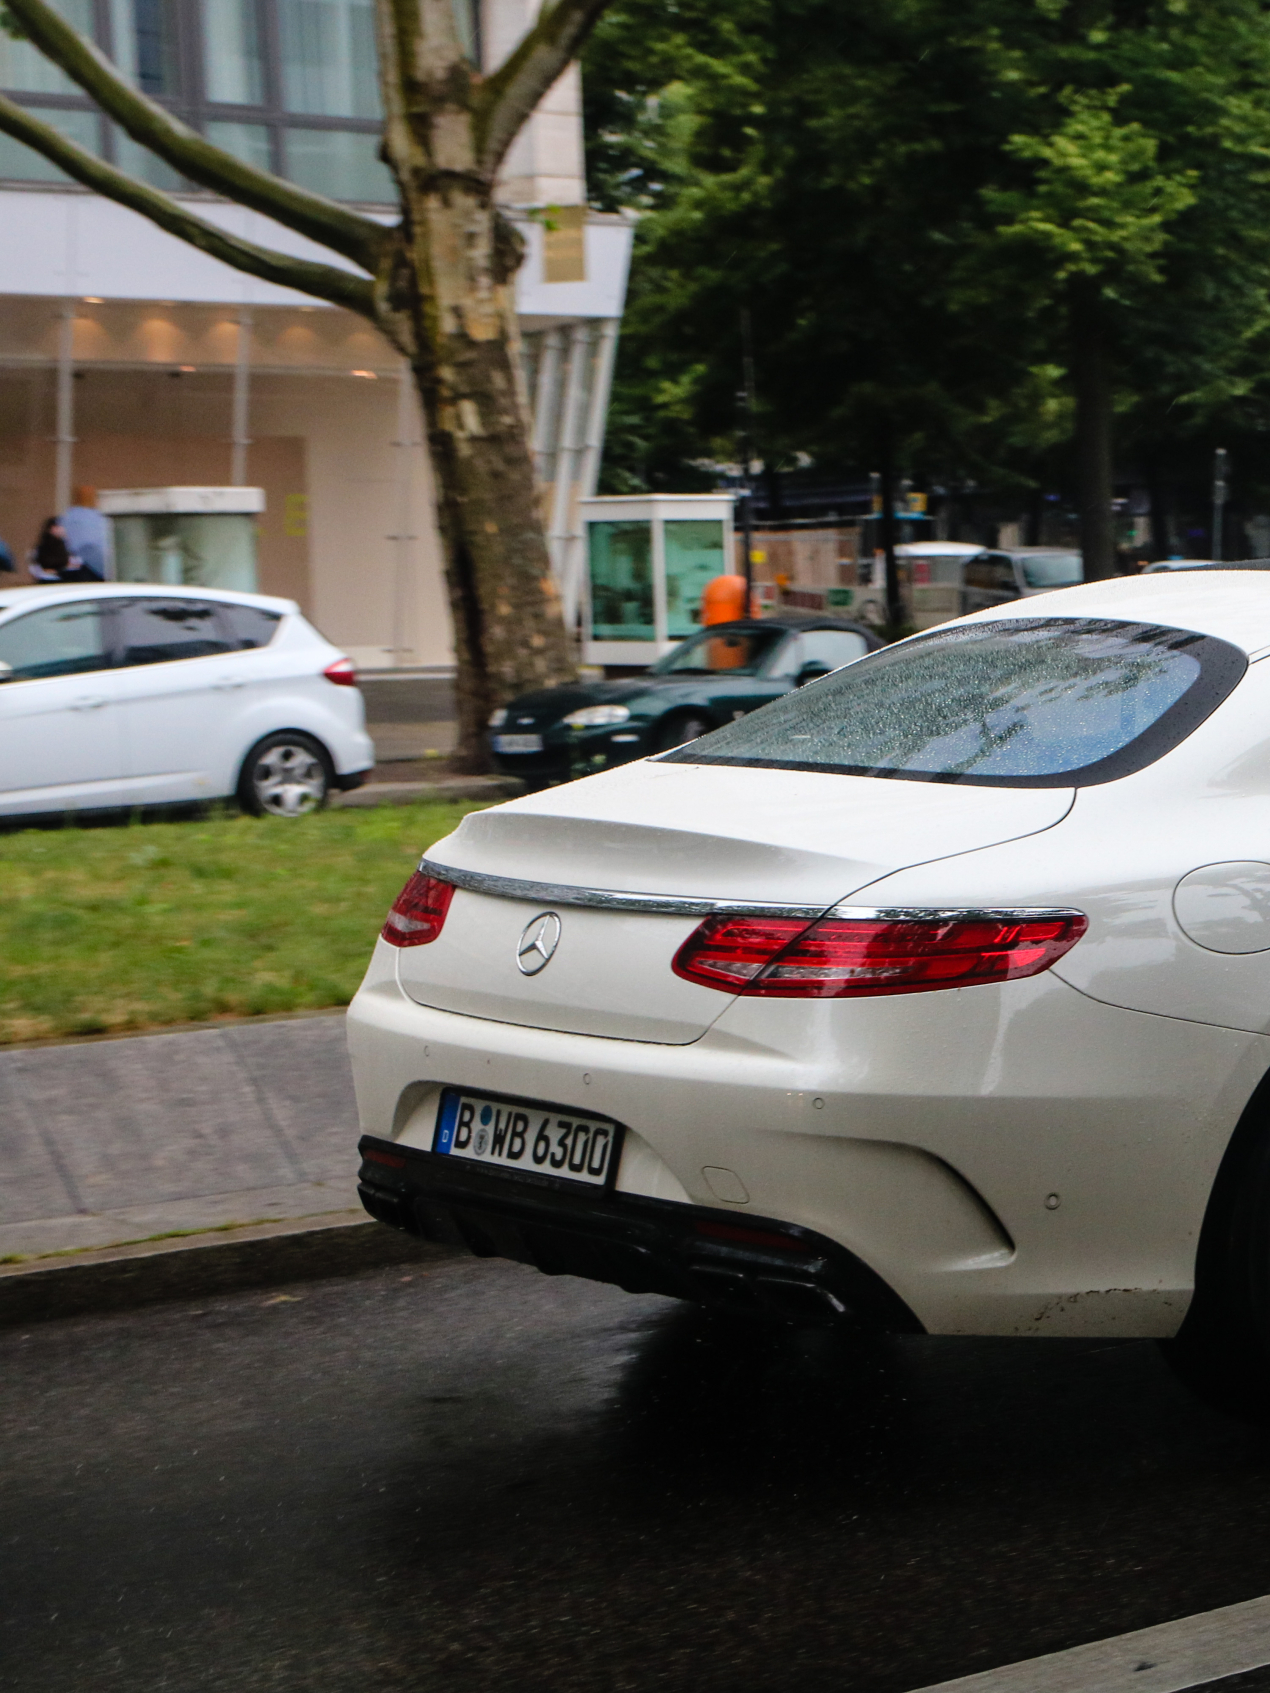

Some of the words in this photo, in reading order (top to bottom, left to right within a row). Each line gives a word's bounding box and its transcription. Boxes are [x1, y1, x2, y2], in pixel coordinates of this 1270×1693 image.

[454, 1102, 475, 1149] B
[490, 1108, 529, 1160] WB
[532, 1118, 609, 1176] 6300
